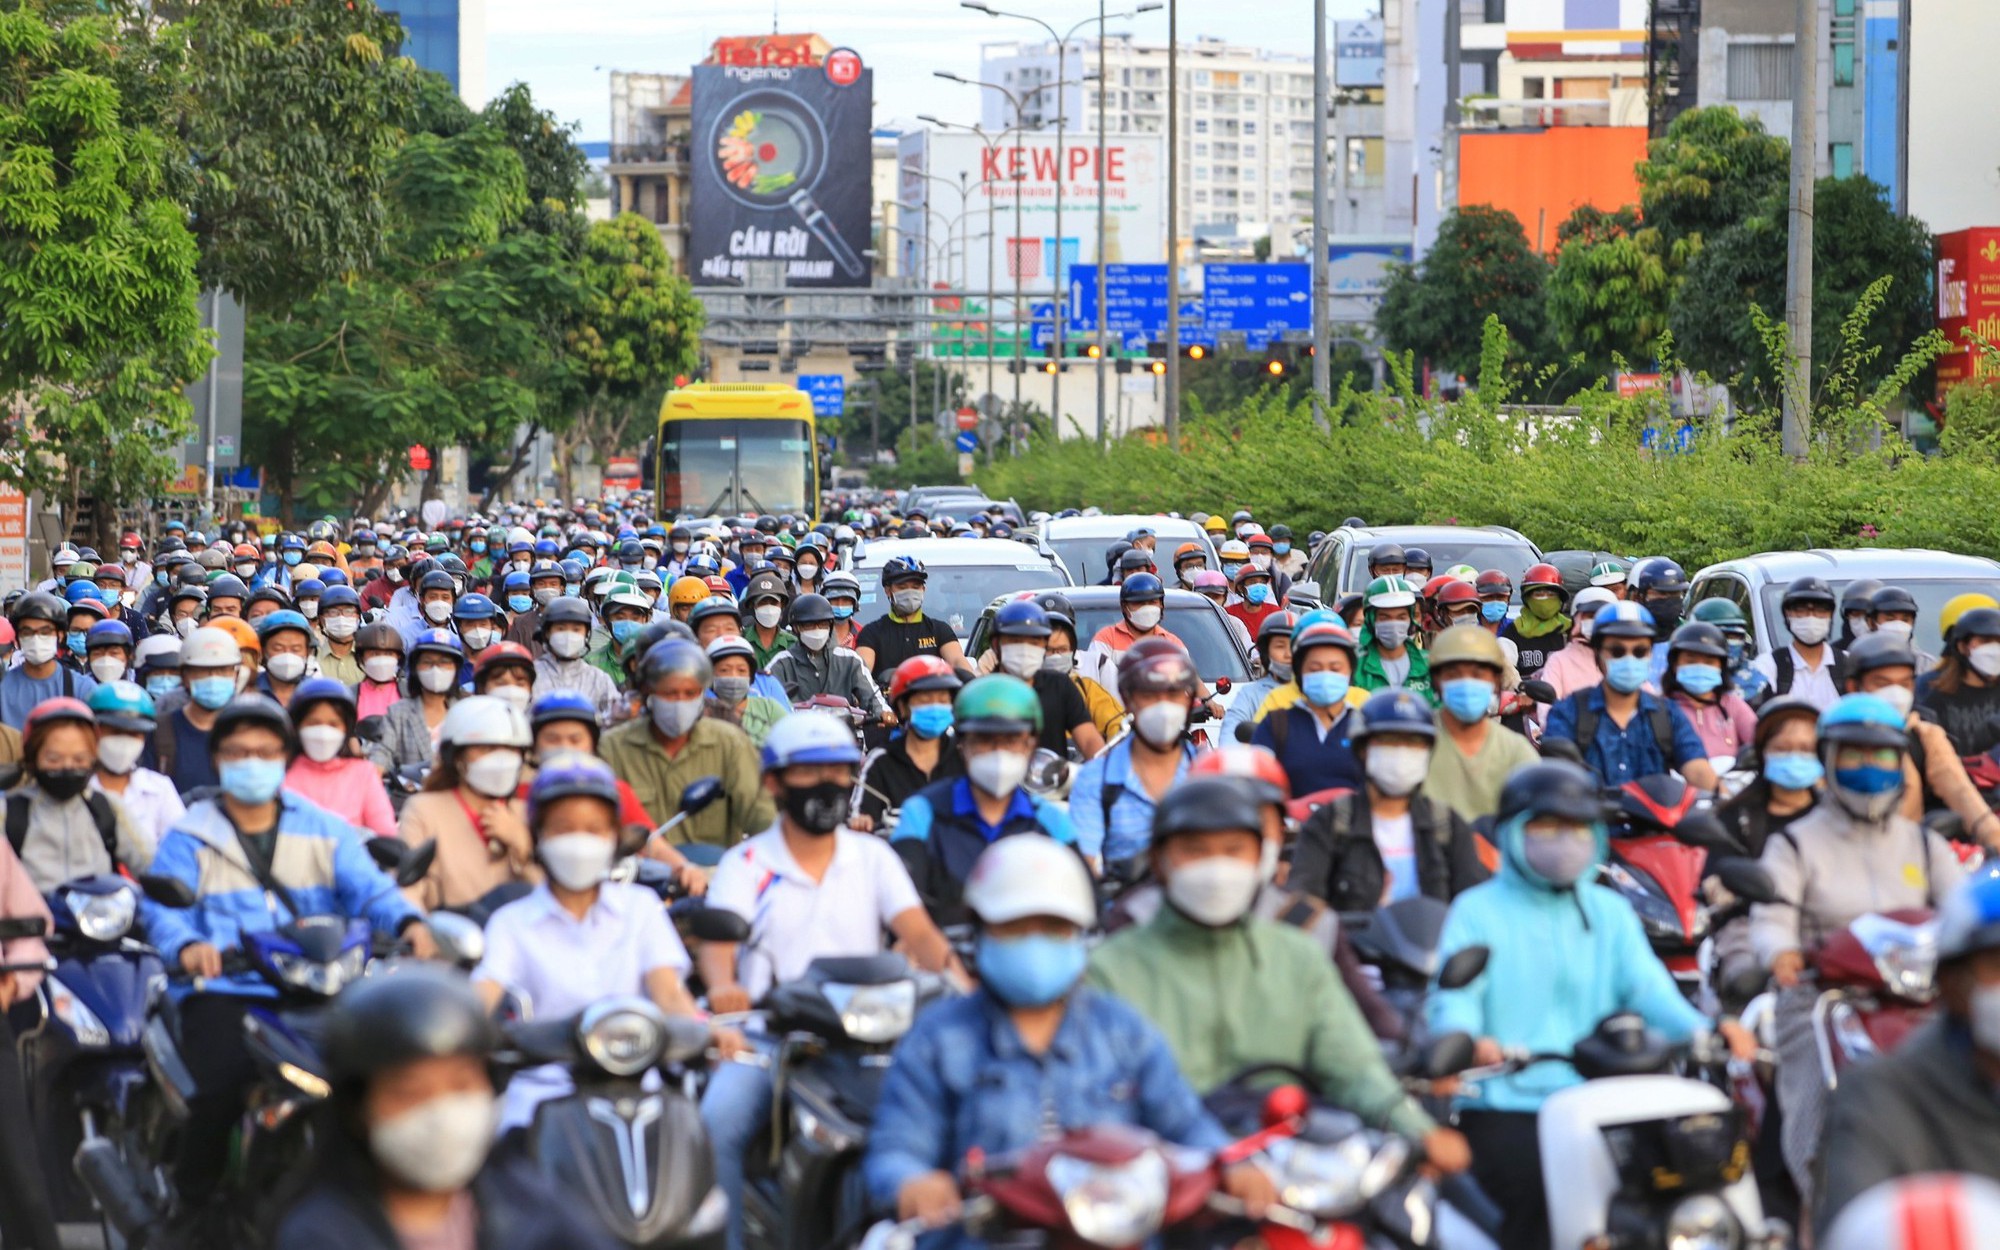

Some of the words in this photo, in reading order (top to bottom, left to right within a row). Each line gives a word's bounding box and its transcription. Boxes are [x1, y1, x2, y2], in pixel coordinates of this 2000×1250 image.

[718, 42, 812, 67] Tefal
[725, 65, 792, 83] ingenio
[982, 147, 1125, 182] KEWPIE
